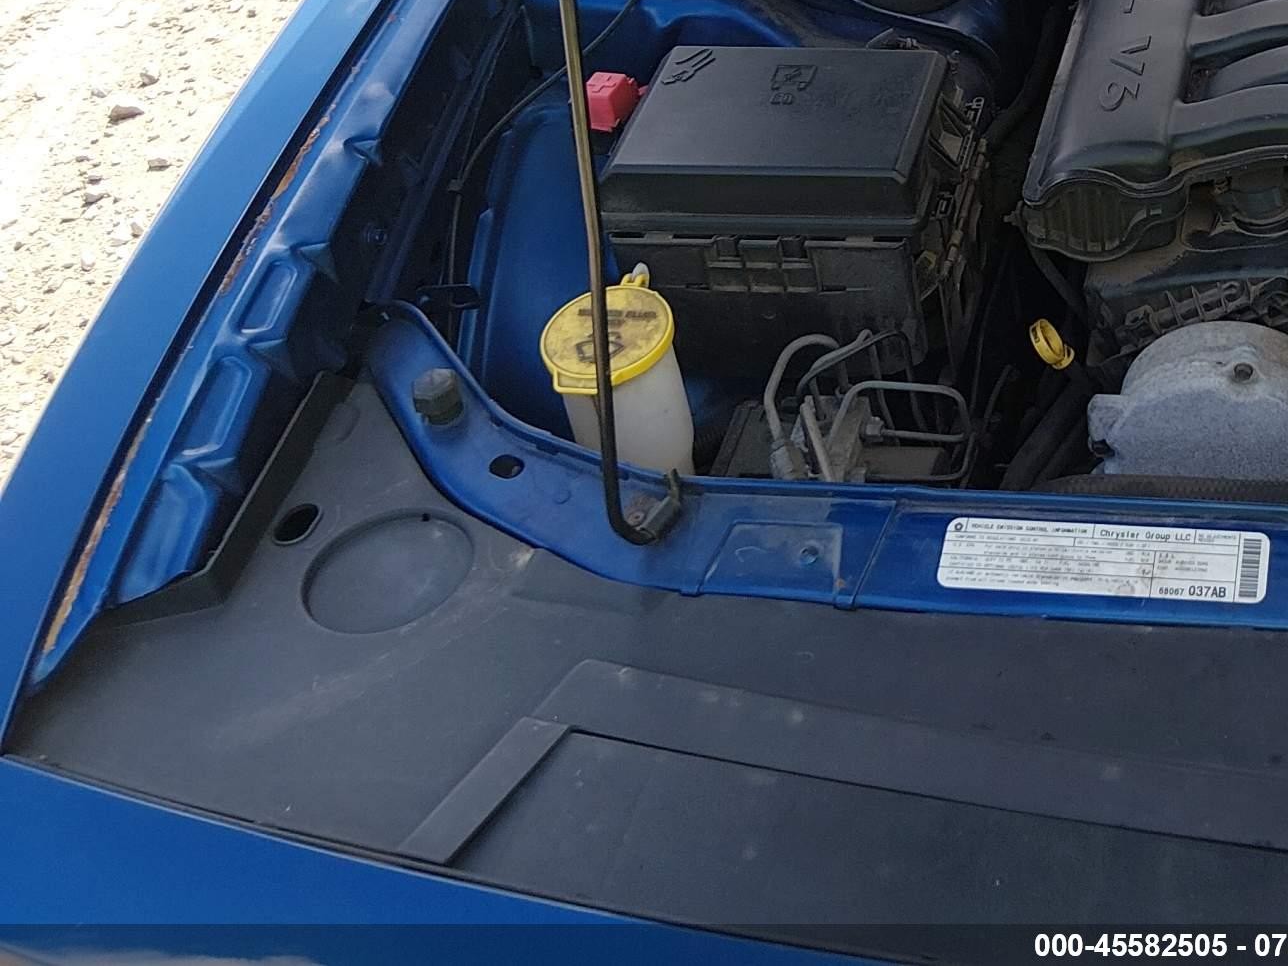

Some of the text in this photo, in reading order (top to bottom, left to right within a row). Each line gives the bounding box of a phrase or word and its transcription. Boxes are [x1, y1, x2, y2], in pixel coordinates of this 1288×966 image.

[1098, 35, 1152, 112] V6
[1100, 529, 1139, 540] Chrysler
[1145, 531, 1171, 542] Group
[1175, 533, 1191, 541] LLC
[1188, 585, 1226, 598] 037AB
